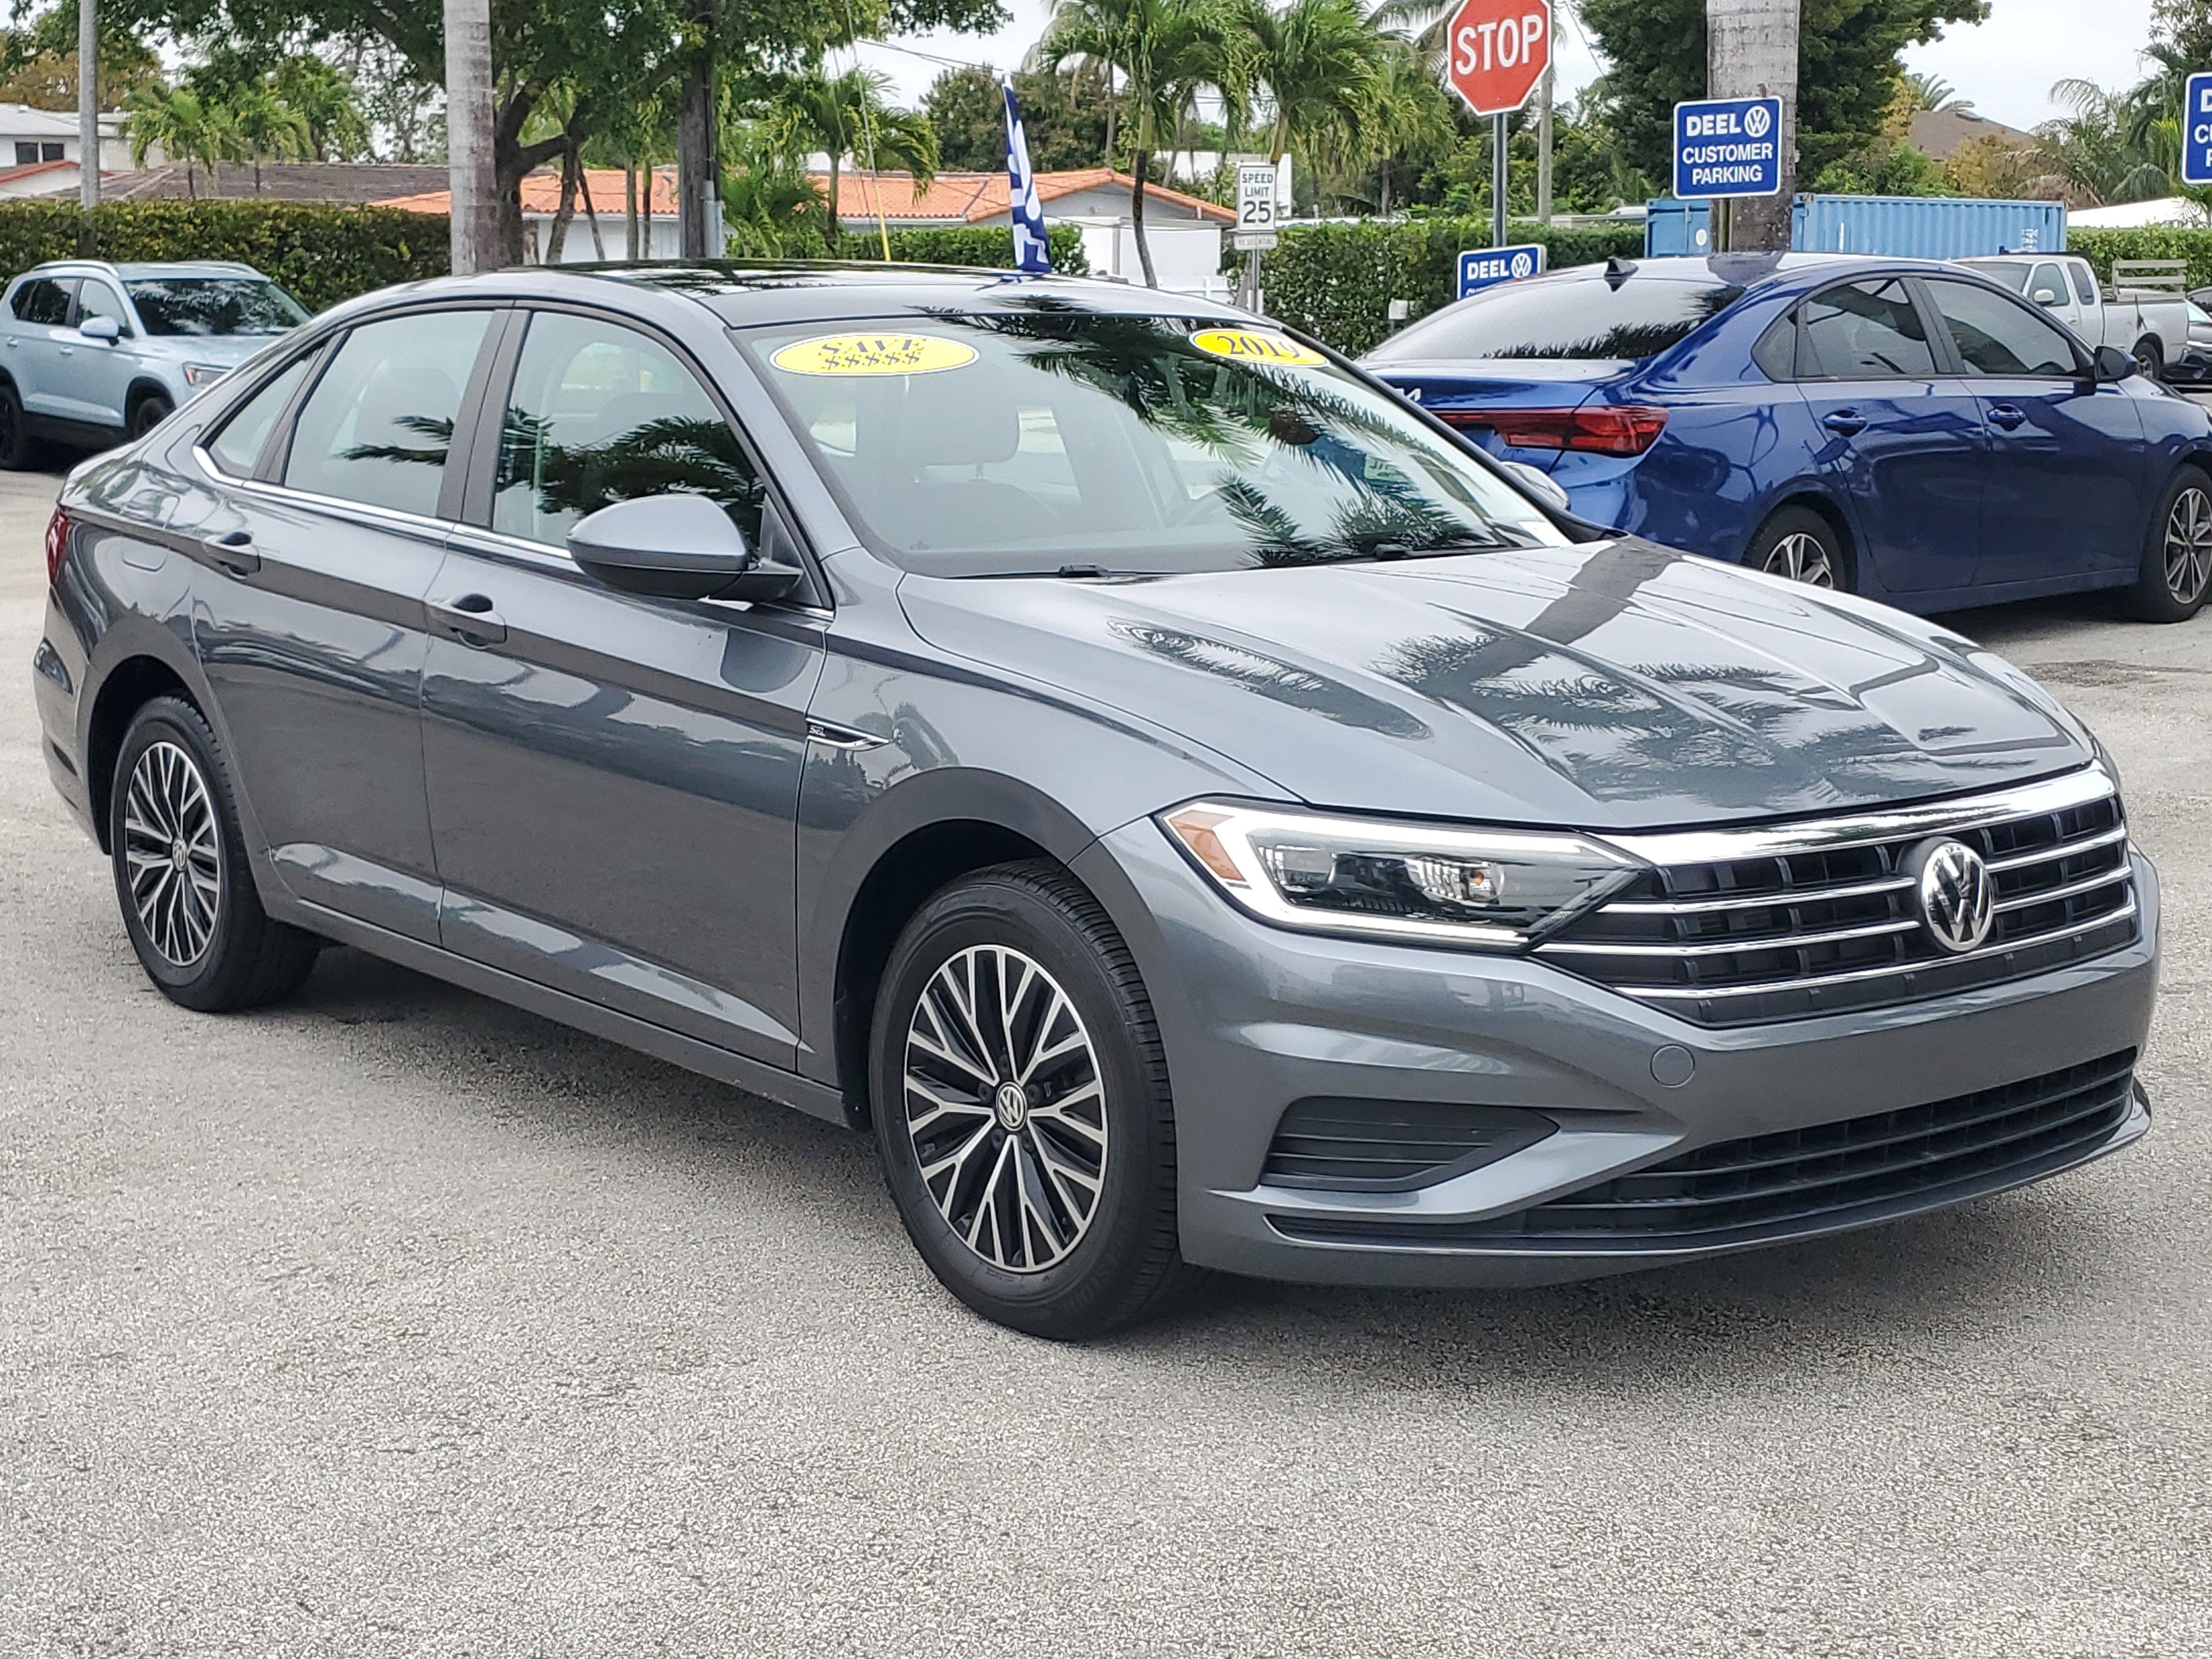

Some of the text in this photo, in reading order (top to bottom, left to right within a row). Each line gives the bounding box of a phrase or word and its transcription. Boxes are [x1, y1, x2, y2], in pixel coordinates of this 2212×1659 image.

[1455, 14, 1543, 76] STOP
[1686, 113, 1742, 137] DEEL
[1682, 142, 1773, 165] CUSTOMER
[1242, 173, 1273, 183] SPEED
[1692, 164, 1763, 185] PARKING
[1244, 187, 1270, 197] LIMIT
[1243, 201, 1271, 223] 25
[1467, 259, 1509, 280] DEEL
[818, 338, 927, 357] SAVE
[1216, 336, 1300, 358] 2019
